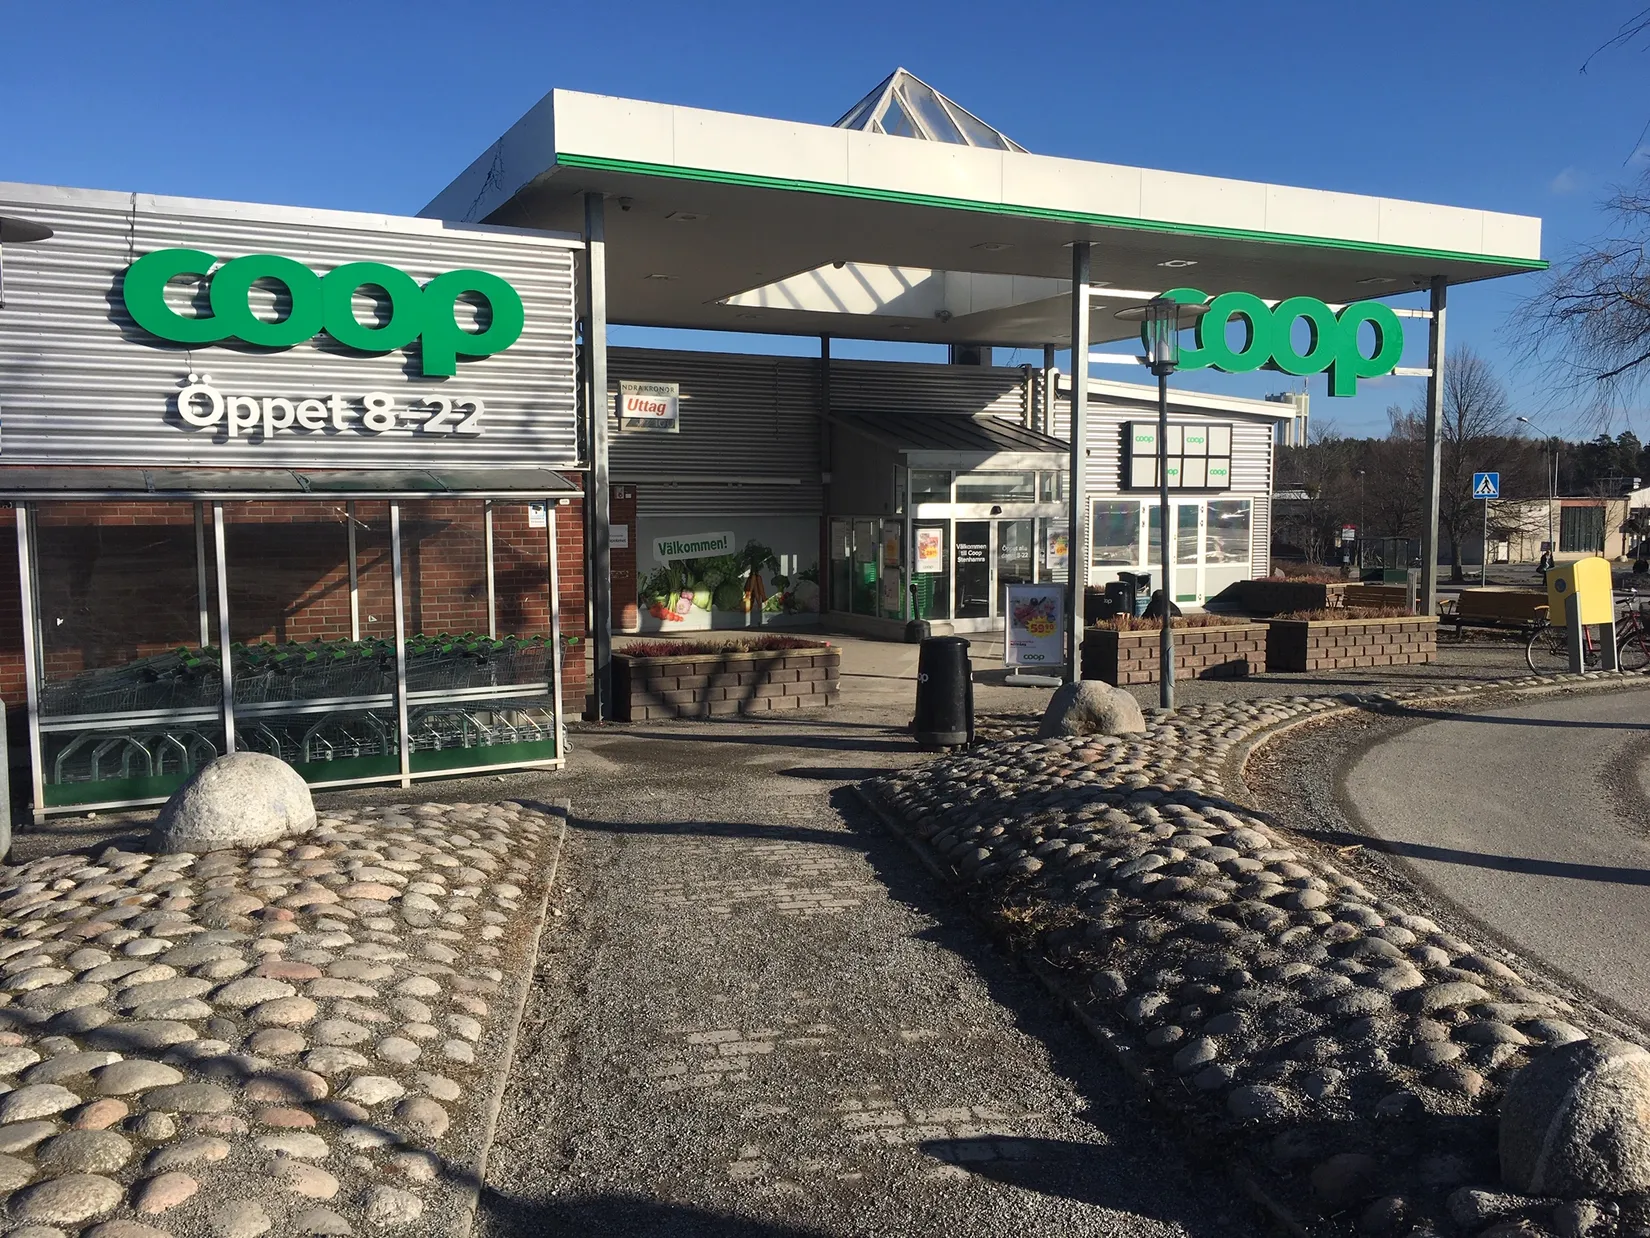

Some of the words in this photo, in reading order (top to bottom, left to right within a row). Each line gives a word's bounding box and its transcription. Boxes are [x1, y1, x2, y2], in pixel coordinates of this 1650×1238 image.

[123, 248, 524, 376] coop
[1141, 287, 1404, 397] coop
[177, 373, 349, 438] Öppet
[627, 398, 666, 416] Uttag
[1135, 435, 1154, 443] coop
[1186, 436, 1204, 444] coop
[1167, 468, 1178, 476] op
[1209, 468, 1227, 476] coop
[658, 535, 728, 556] Välkommen!
[968, 549, 982, 557] Coop
